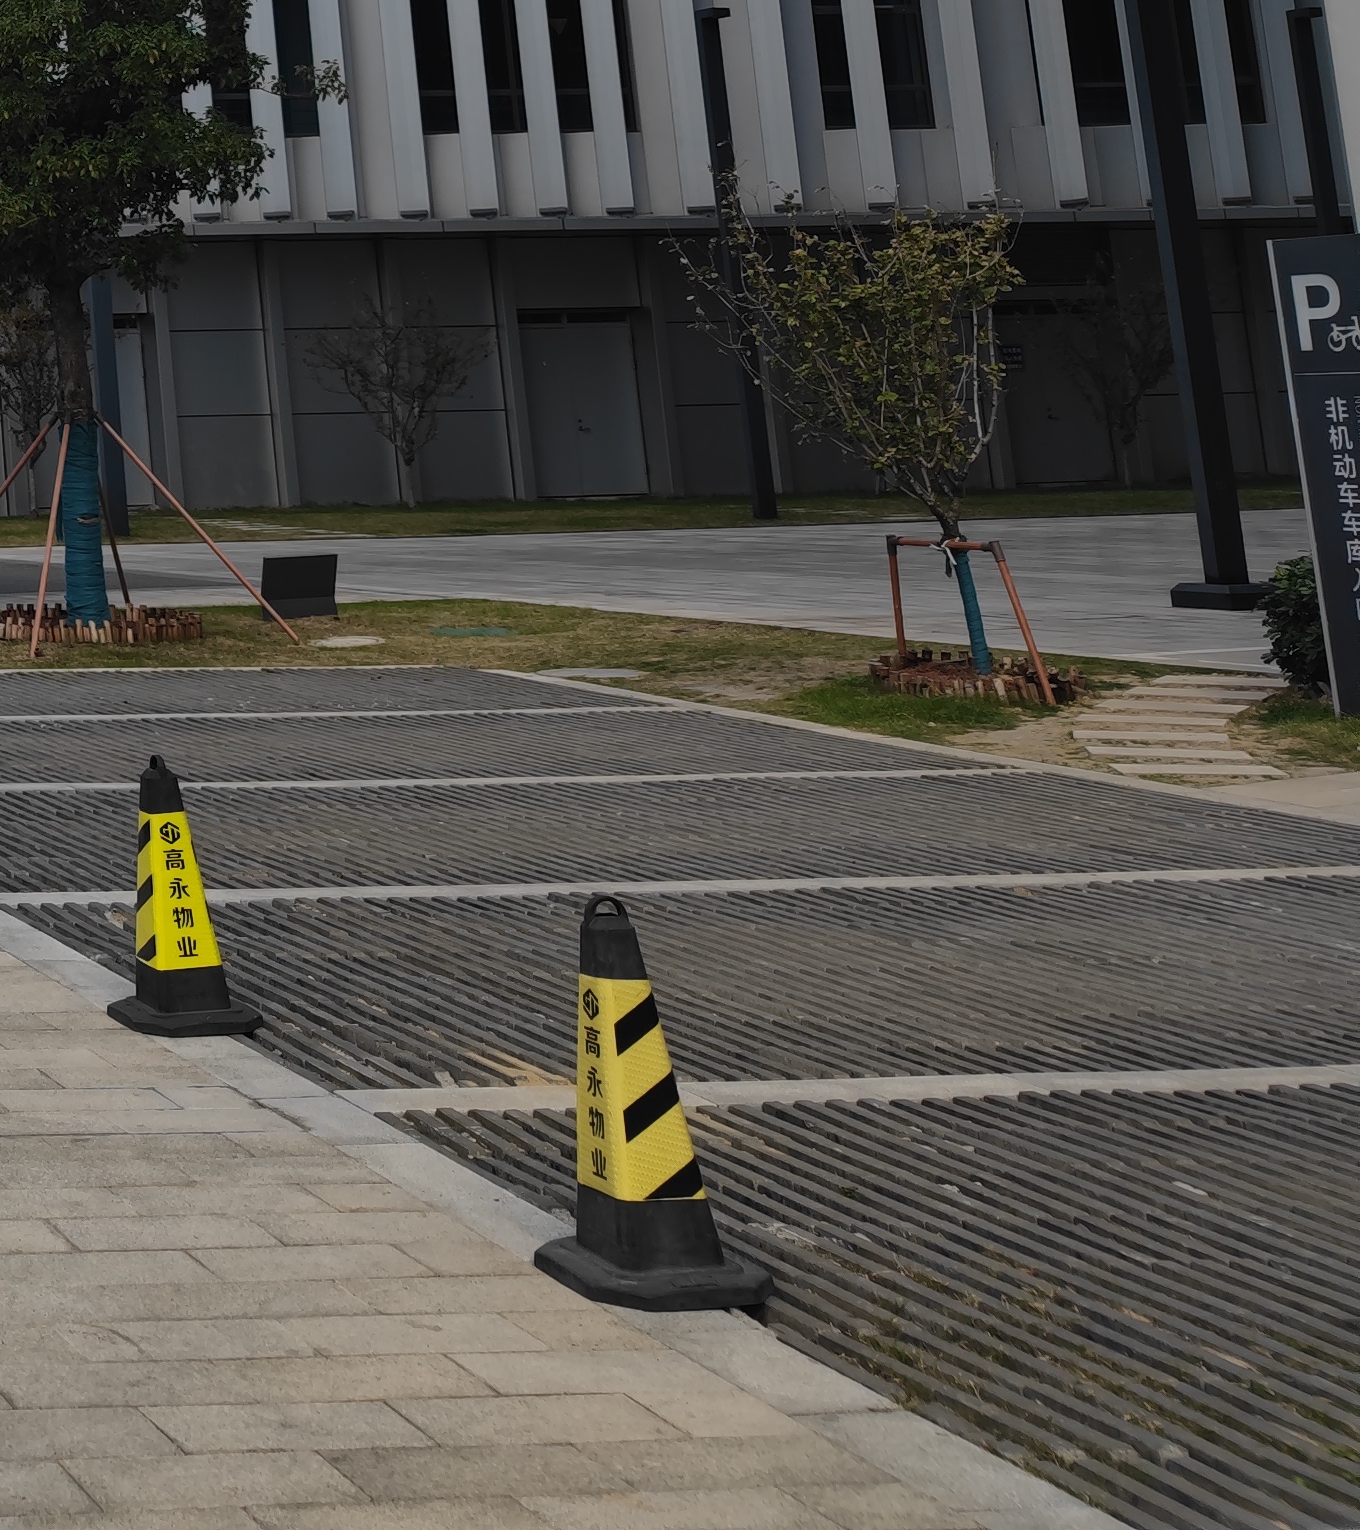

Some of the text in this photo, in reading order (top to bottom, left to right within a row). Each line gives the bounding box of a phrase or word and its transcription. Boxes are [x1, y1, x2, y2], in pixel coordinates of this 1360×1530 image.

[1290, 273, 1341, 352] P
[1324, 396, 1360, 621] 非机动车车库
[163, 848, 199, 958] 高永物业
[583, 1024, 608, 1182] 高永物业
